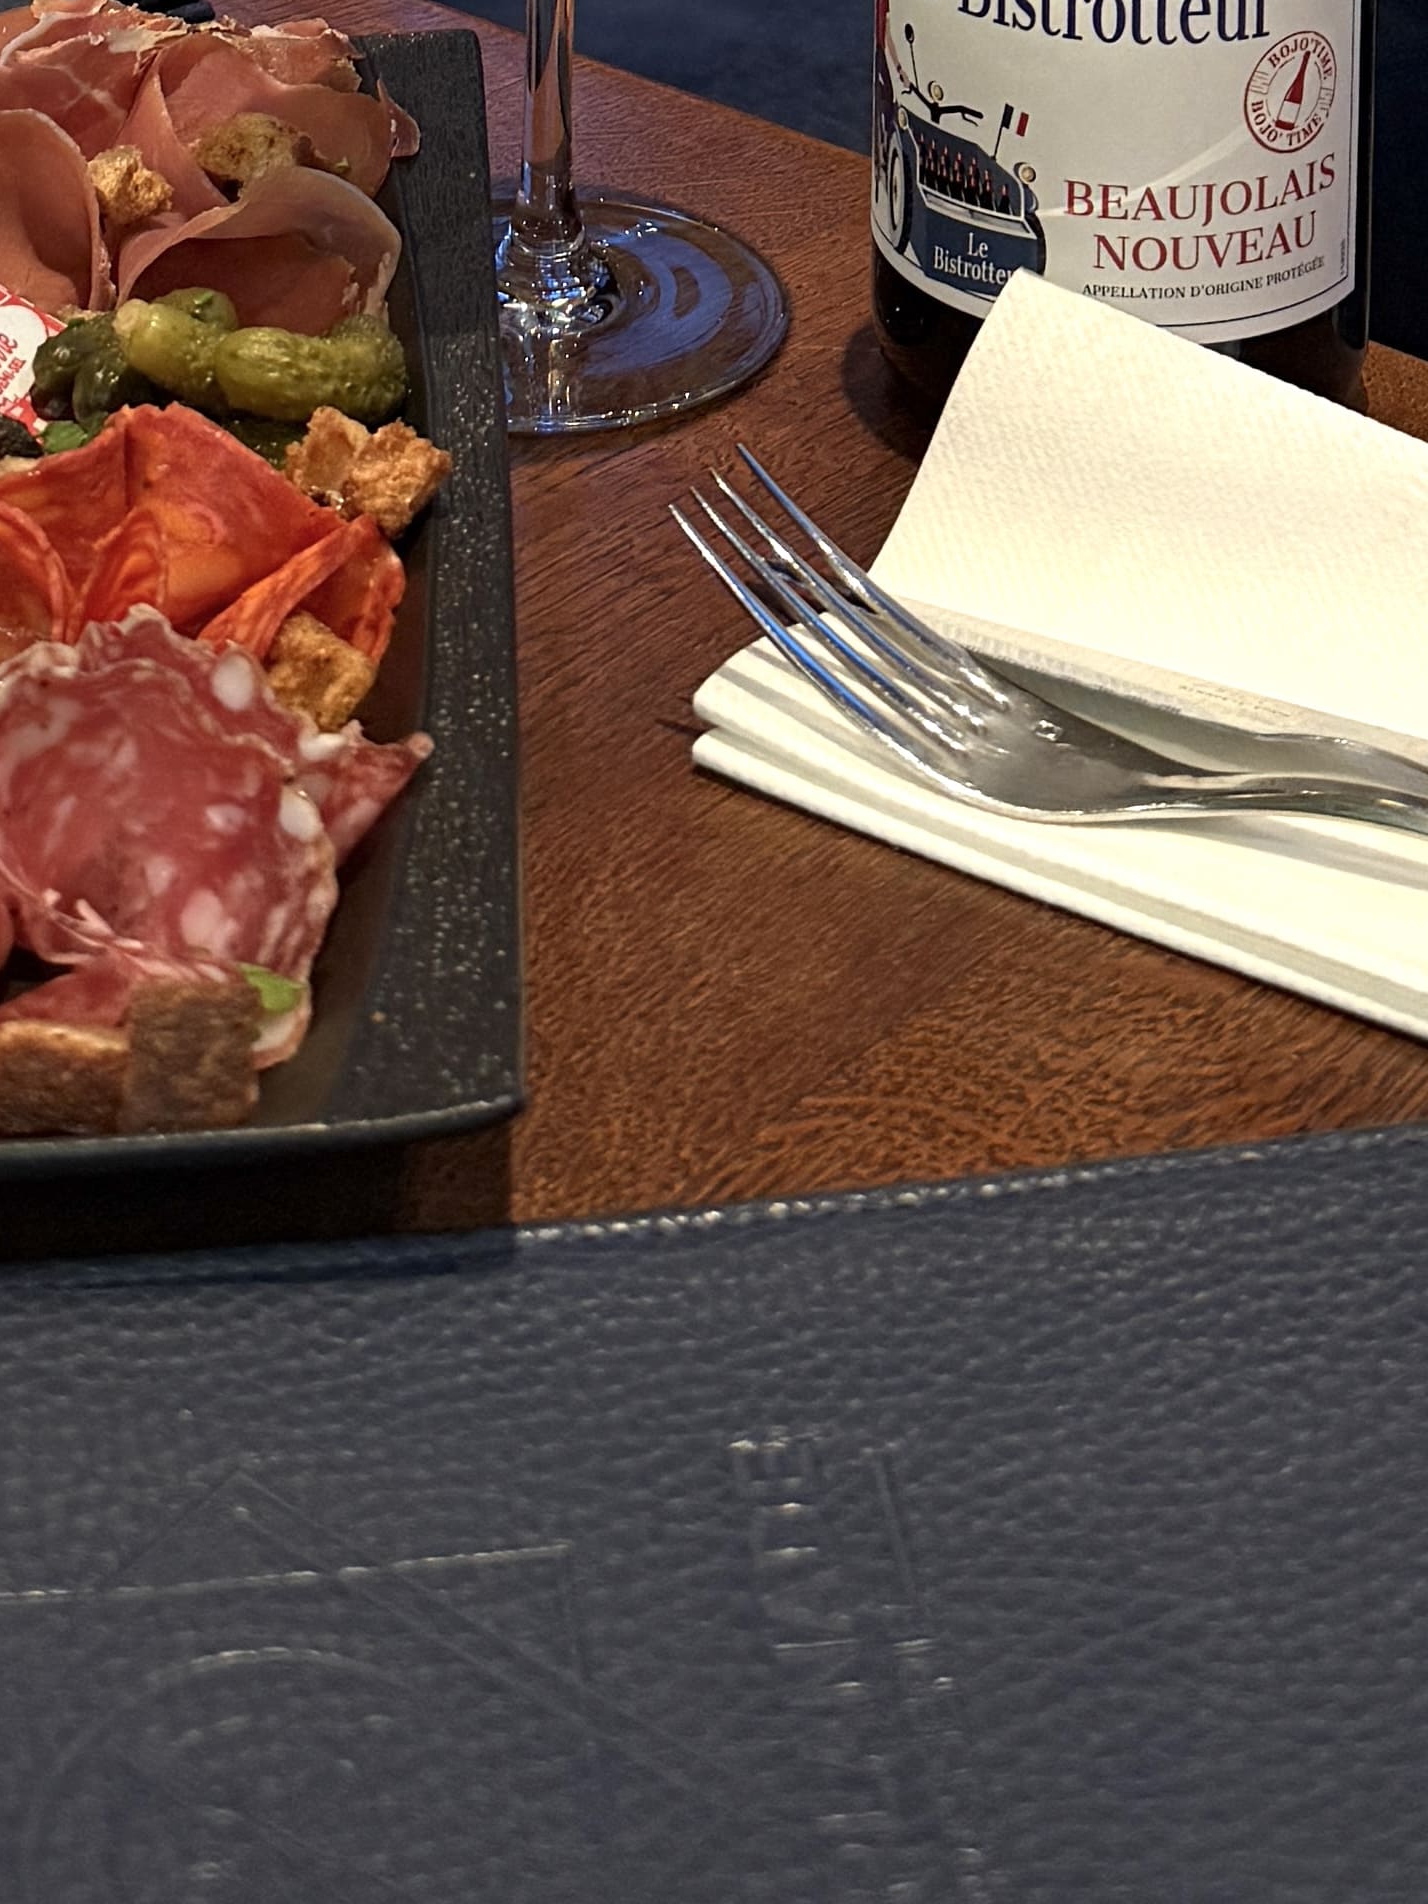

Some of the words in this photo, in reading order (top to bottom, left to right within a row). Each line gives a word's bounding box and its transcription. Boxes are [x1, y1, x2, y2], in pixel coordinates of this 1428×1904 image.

[1064, 153, 1335, 227] BEAUJOLAIS
[967, 232, 989, 258] Le
[1093, 211, 1317, 271] NOUVEAU
[933, 245, 1012, 286] Bistrotte
[1082, 283, 1186, 300] APPELLATION
[1190, 277, 1263, 298] D'ORIGINE
[1266, 255, 1325, 286] PROTÉGÉE
